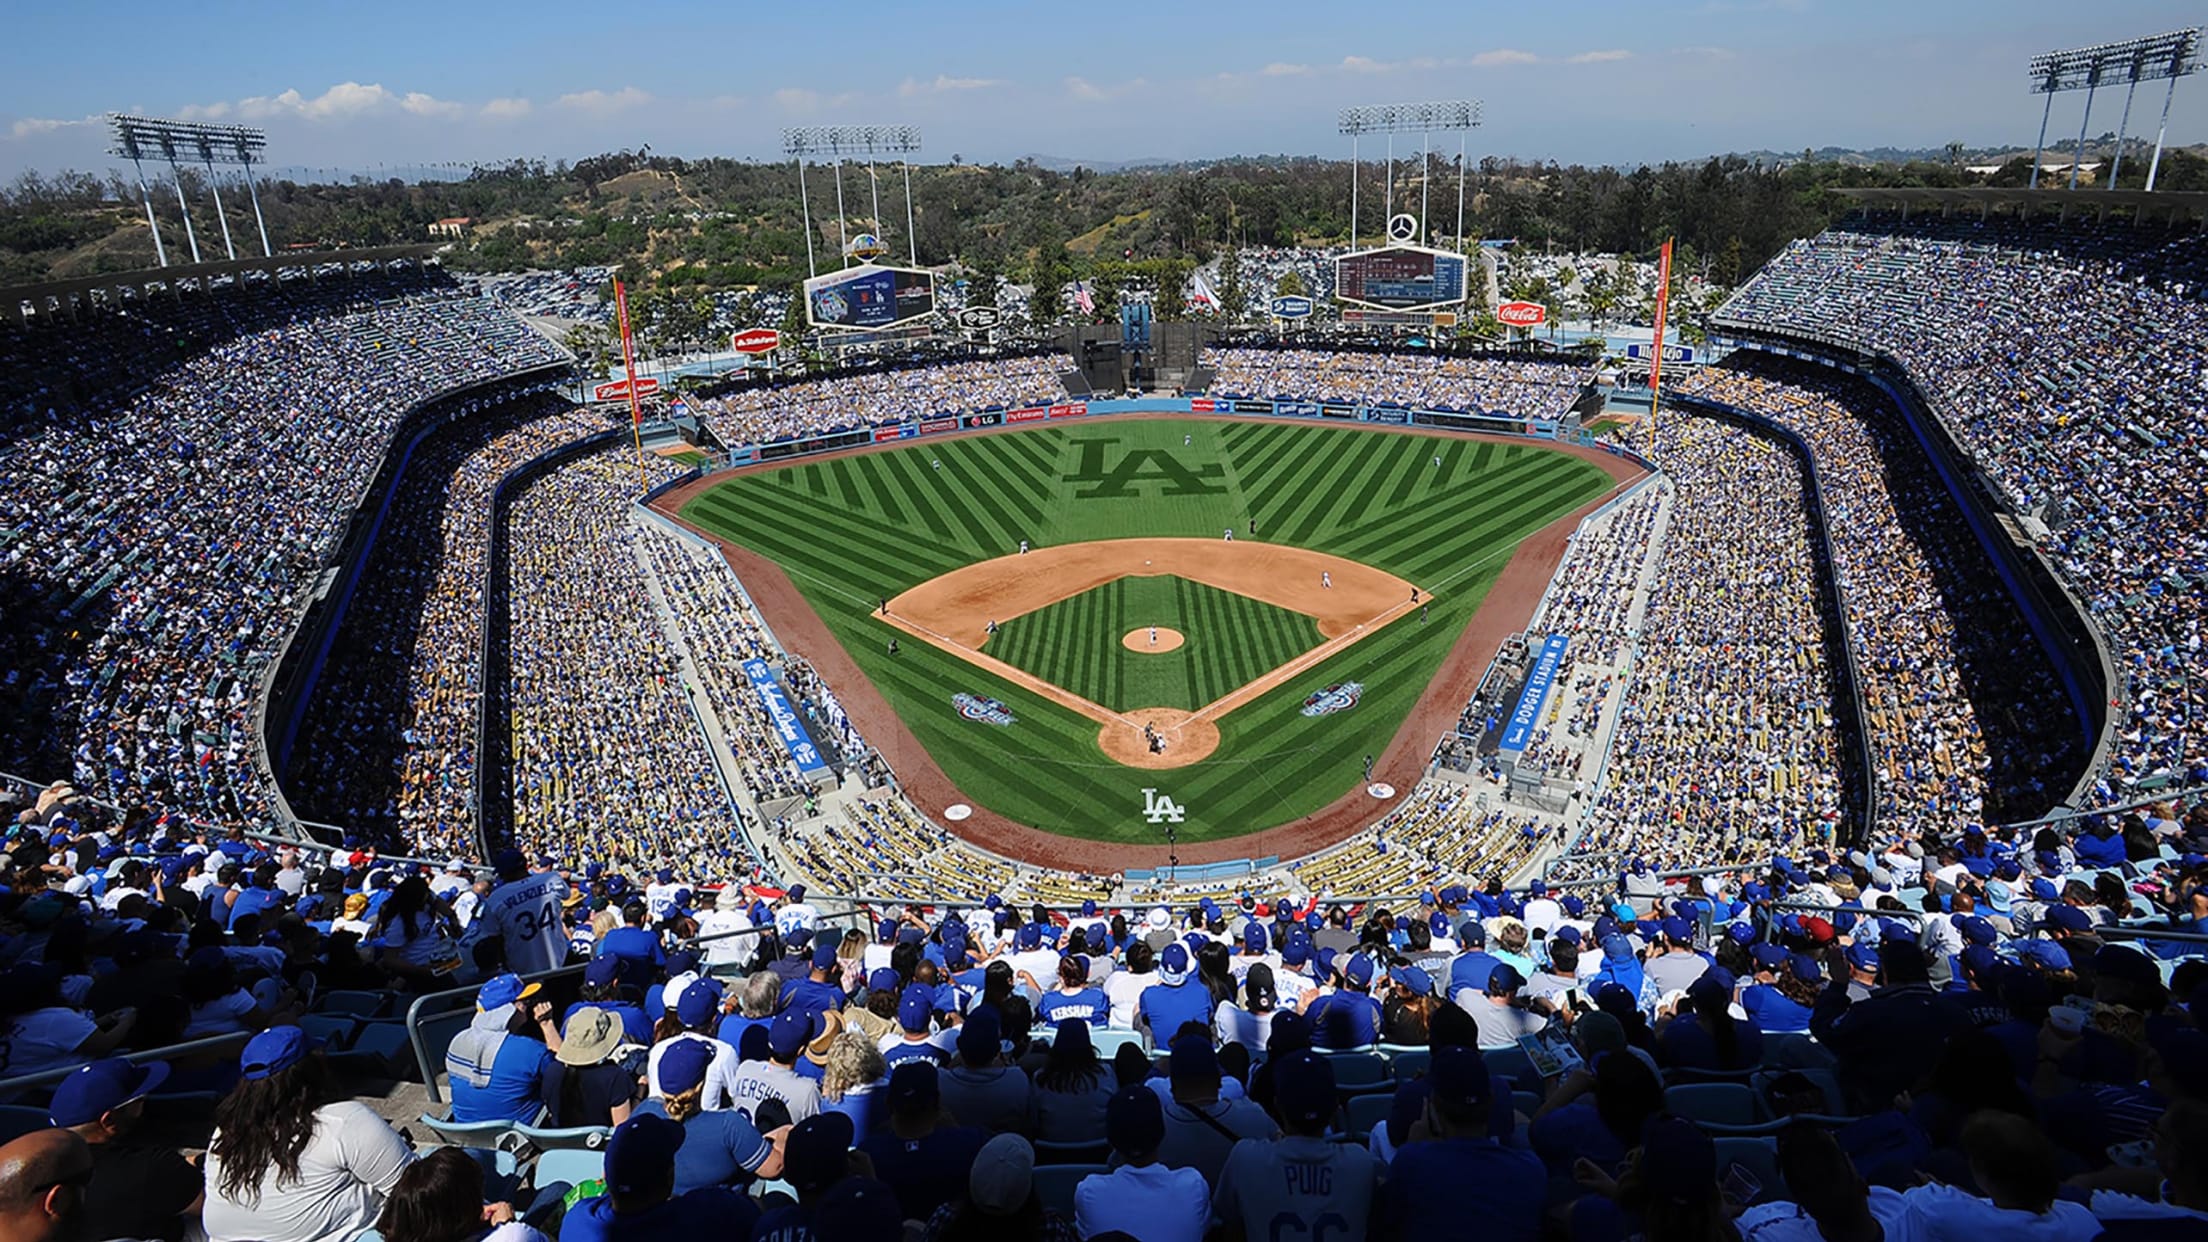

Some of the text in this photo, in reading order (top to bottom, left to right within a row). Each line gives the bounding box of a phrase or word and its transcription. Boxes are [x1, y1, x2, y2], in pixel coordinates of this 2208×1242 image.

[1500, 307, 1540, 321] Coca-Cola
[981, 416, 994, 425] LG
[1062, 438, 1228, 498] LA
[1515, 687, 1542, 725] DODGER
[1533, 652, 1558, 687] STADIUM
[1141, 788, 1185, 823] LA
[503, 882, 553, 909] VALENZUELA
[515, 902, 556, 941] 34
[1050, 1004, 1094, 1021] KERSHAW
[1284, 1164, 1333, 1196] PUIG
[758, 1225, 817, 1242] ONZ
